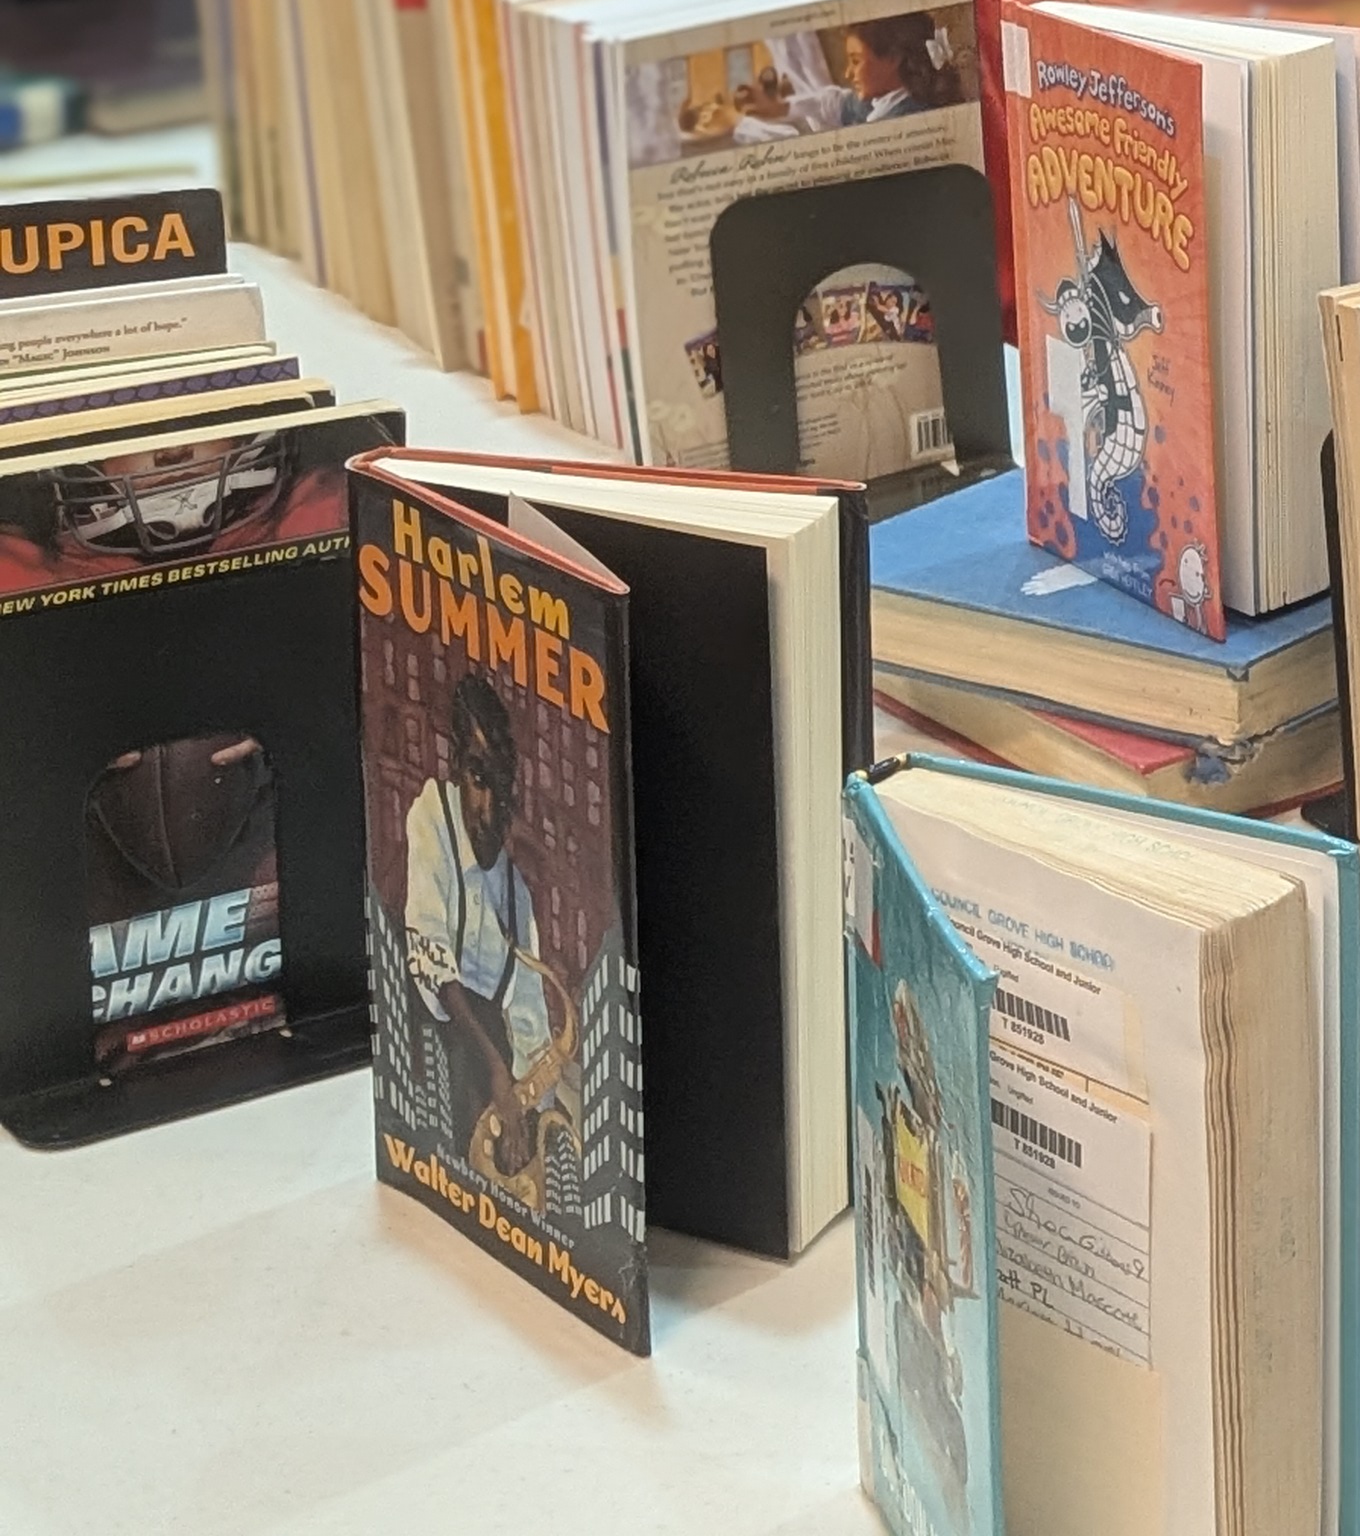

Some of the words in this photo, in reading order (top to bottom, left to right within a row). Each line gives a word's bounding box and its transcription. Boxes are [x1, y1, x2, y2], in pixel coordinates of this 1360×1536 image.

[1029, 102, 1112, 145] Awesome
[1036, 60, 1087, 100] Rowley
[1089, 70, 1176, 137] Jefferson's
[1027, 145, 1195, 272] ADVENTURE
[0, 213, 196, 274] UPICA
[55, 329, 113, 344] everywhere
[124, 325, 138, 335] lot
[41, 585, 96, 608] YORK
[101, 573, 163, 597] TIMES
[168, 546, 298, 584] BESTSELLING
[393, 499, 570, 640] Harlem
[359, 544, 610, 734] SUMMER
[949, 917, 975, 938] ouncil
[977, 929, 1001, 949] Grove
[1003, 941, 1022, 960] High
[1024, 951, 1055, 974] School
[1056, 965, 1071, 982] and
[1073, 975, 1101, 995] Junior
[988, 909, 1029, 938] GROVE
[1035, 929, 1064, 951] HIGH
[149, 1000, 275, 1041] SCHOLASTIC
[1002, 1017, 1008, 1029] T
[1016, 1065, 1036, 1083] High
[1038, 1075, 1069, 1098] School
[1071, 1092, 1087, 1109] and
[1014, 1138, 1020, 1151] T
[384, 1134, 475, 1214] Walter
[479, 1194, 543, 1265] Dean
[549, 1241, 626, 1324] Myers
[490, 1181, 528, 1216] Honor
[530, 1207, 576, 1249] Winner
